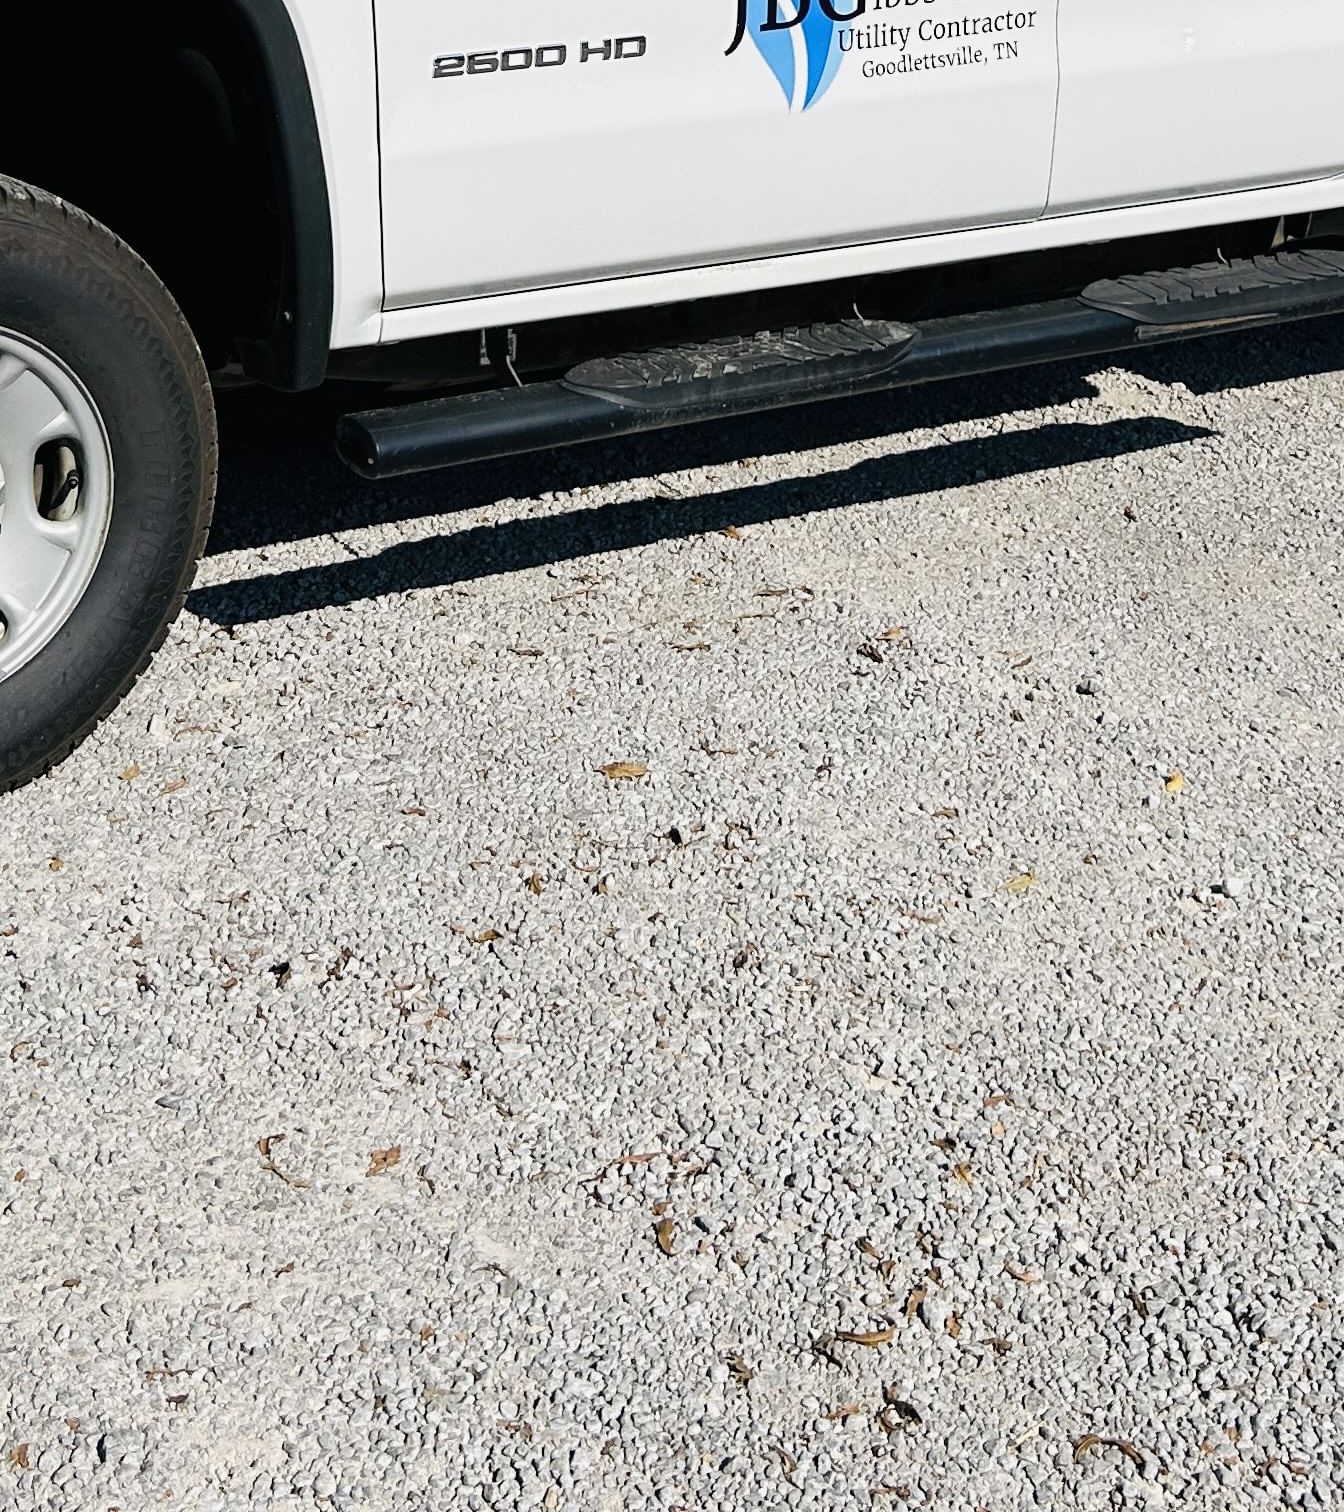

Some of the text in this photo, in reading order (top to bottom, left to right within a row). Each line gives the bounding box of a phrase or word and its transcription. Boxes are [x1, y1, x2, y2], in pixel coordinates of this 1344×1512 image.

[579, 35, 647, 63] HD
[838, 9, 1037, 51] Utility Contractor
[862, 40, 1018, 78] Goodlettsville, TN
